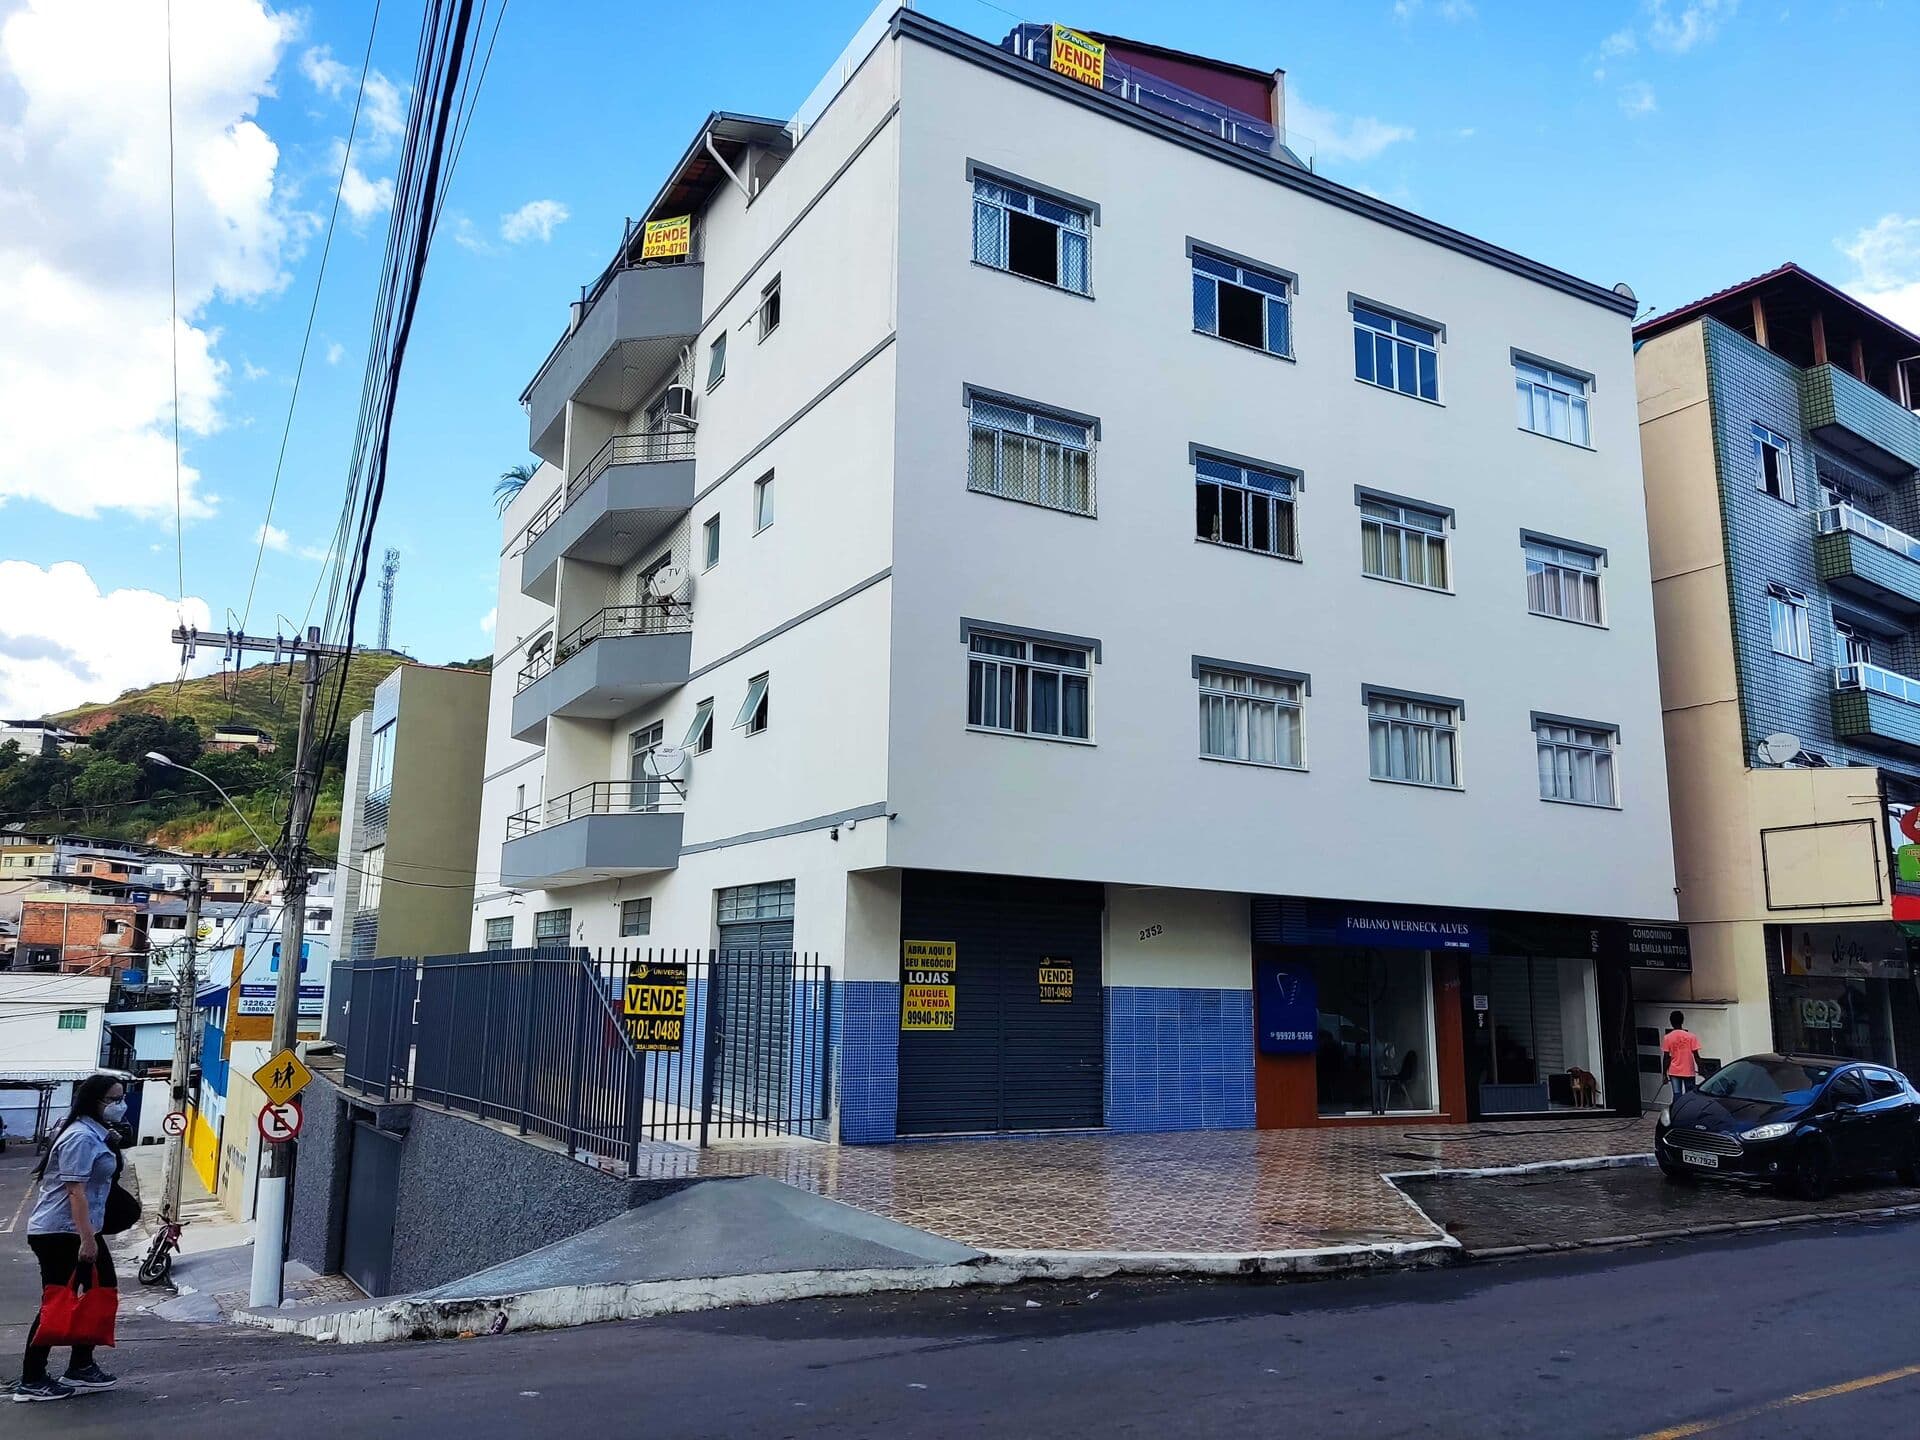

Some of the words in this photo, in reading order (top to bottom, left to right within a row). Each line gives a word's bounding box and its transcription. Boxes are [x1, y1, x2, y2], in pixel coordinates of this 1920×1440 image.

[1055, 40, 1101, 75] VENDE
[647, 227, 687, 244] VENDE
[644, 242, 687, 256] 3229-4710
[668, 567, 681, 577] TV
[1346, 917, 1390, 930] FABIANO
[1391, 919, 1438, 933] WERNECK
[1439, 922, 1469, 935] ALVES
[907, 945, 927, 955] ABRA
[928, 946, 945, 956] AQUI
[946, 946, 952, 956] O
[1629, 943, 1640, 953] RIA
[1663, 945, 1688, 956] MATTOS
[905, 958, 919, 968] SEU
[653, 967, 686, 976] UNIVERSAL
[908, 971, 949, 984] LOJAS
[1040, 970, 1072, 983] VENDE
[628, 987, 685, 1012] VENDE
[908, 989, 949, 998] ALUGUEL
[243, 999, 276, 1007] 3226.22
[920, 999, 950, 1008] VENDA
[907, 1010, 954, 1026] 99940-8785
